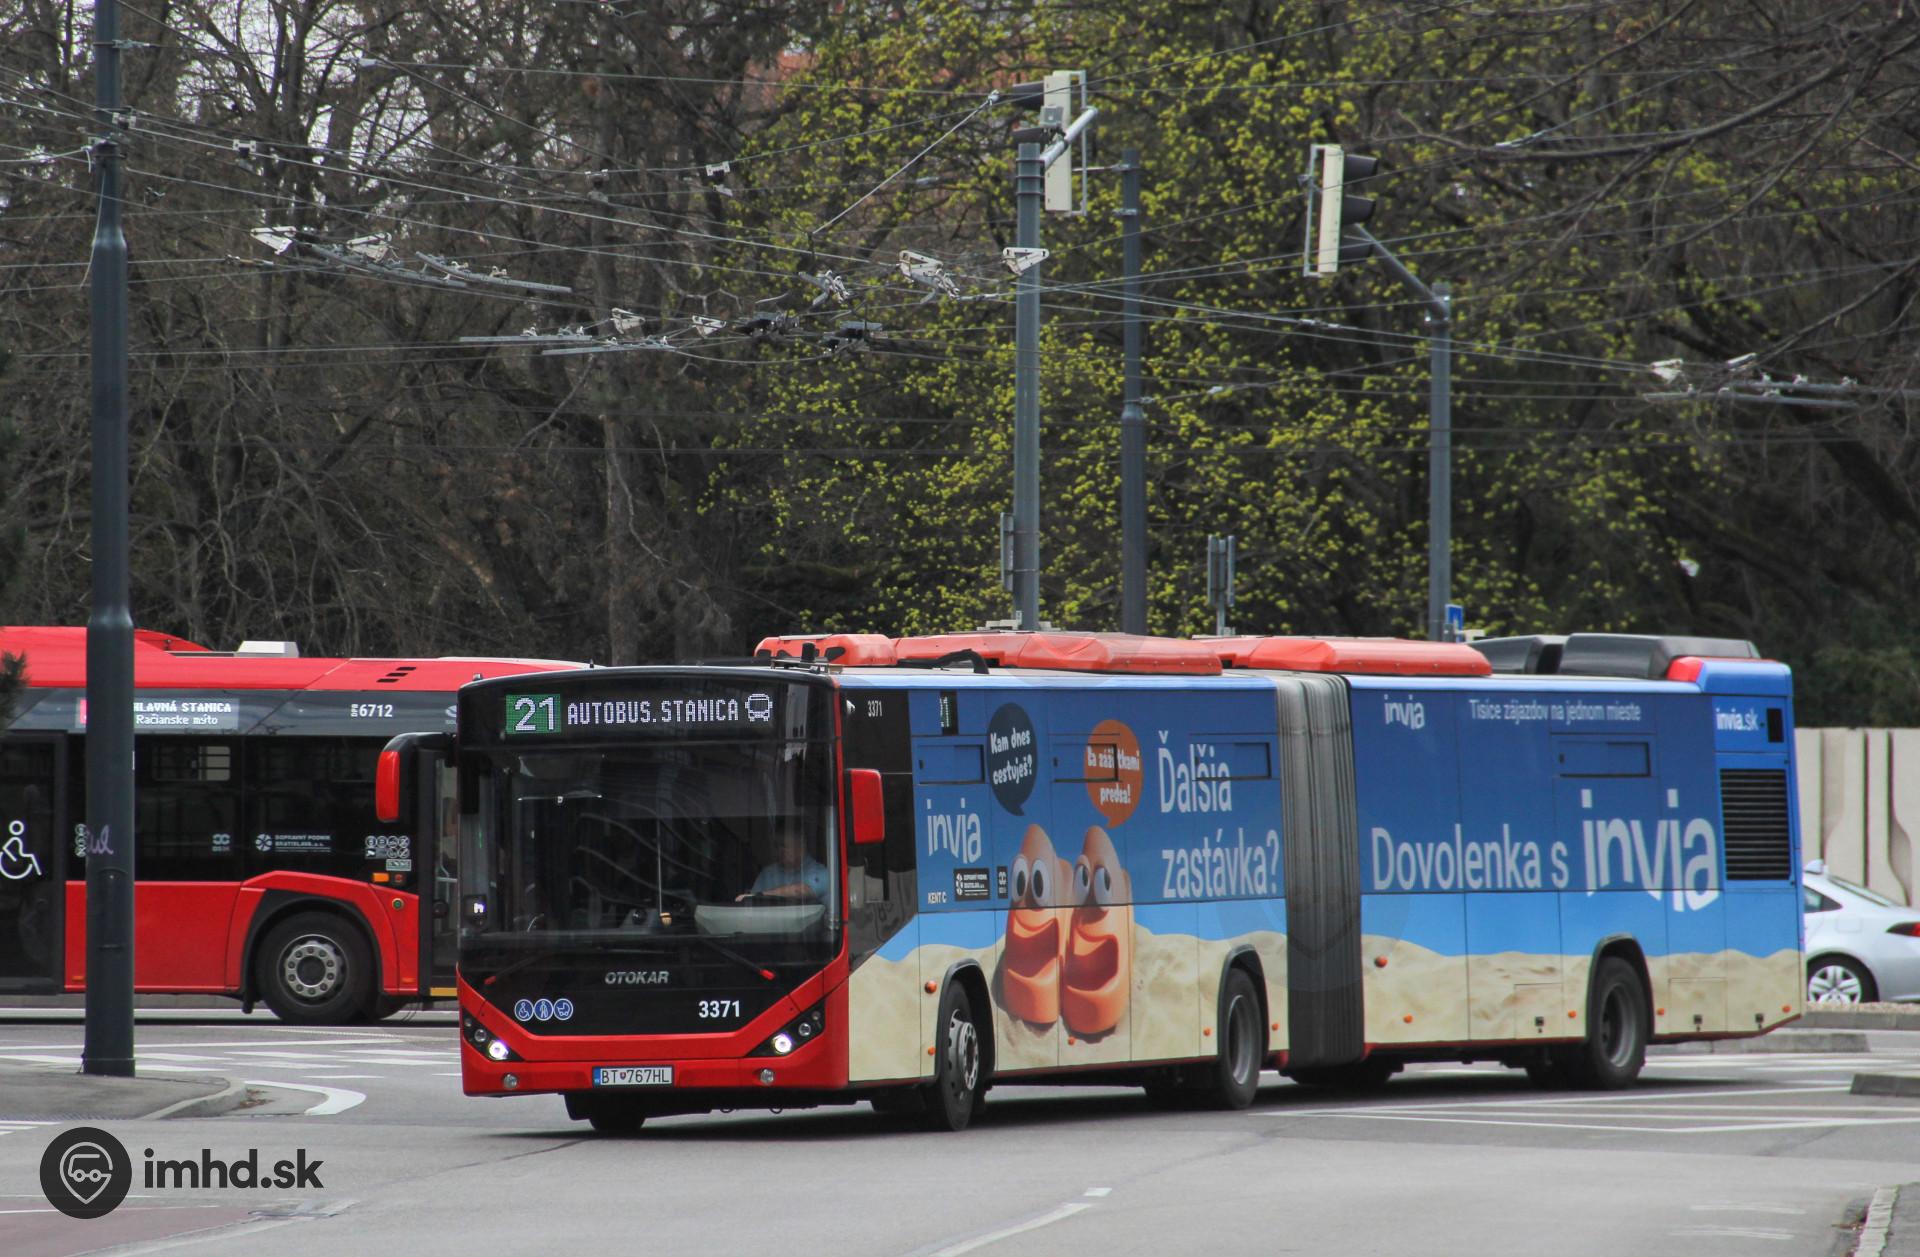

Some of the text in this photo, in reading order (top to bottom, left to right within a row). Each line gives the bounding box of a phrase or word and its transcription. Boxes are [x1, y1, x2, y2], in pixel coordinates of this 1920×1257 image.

[136, 713, 218, 725] Račianske mýto
[181, 702, 232, 713] STANICA
[359, 704, 393, 717] 6712
[515, 697, 554, 731] 21
[867, 700, 883, 717] 3371
[1384, 694, 1425, 730] invia
[1469, 699, 1641, 725] Tisíce zájazdov na jednom mieste
[1716, 707, 1759, 731] invia.sk
[990, 727, 1031, 754] Kam dnes
[993, 754, 1033, 785] cestuješ?
[1158, 729, 1232, 814] Ďalšia
[1100, 783, 1131, 805] predsa!
[926, 798, 982, 864] invia
[1371, 788, 1720, 912] Dovolenka s invia
[1162, 828, 1280, 899] zastávka?
[927, 892, 941, 904] KENT
[605, 970, 670, 985] OTOKAR
[698, 1000, 741, 1018] 3371
